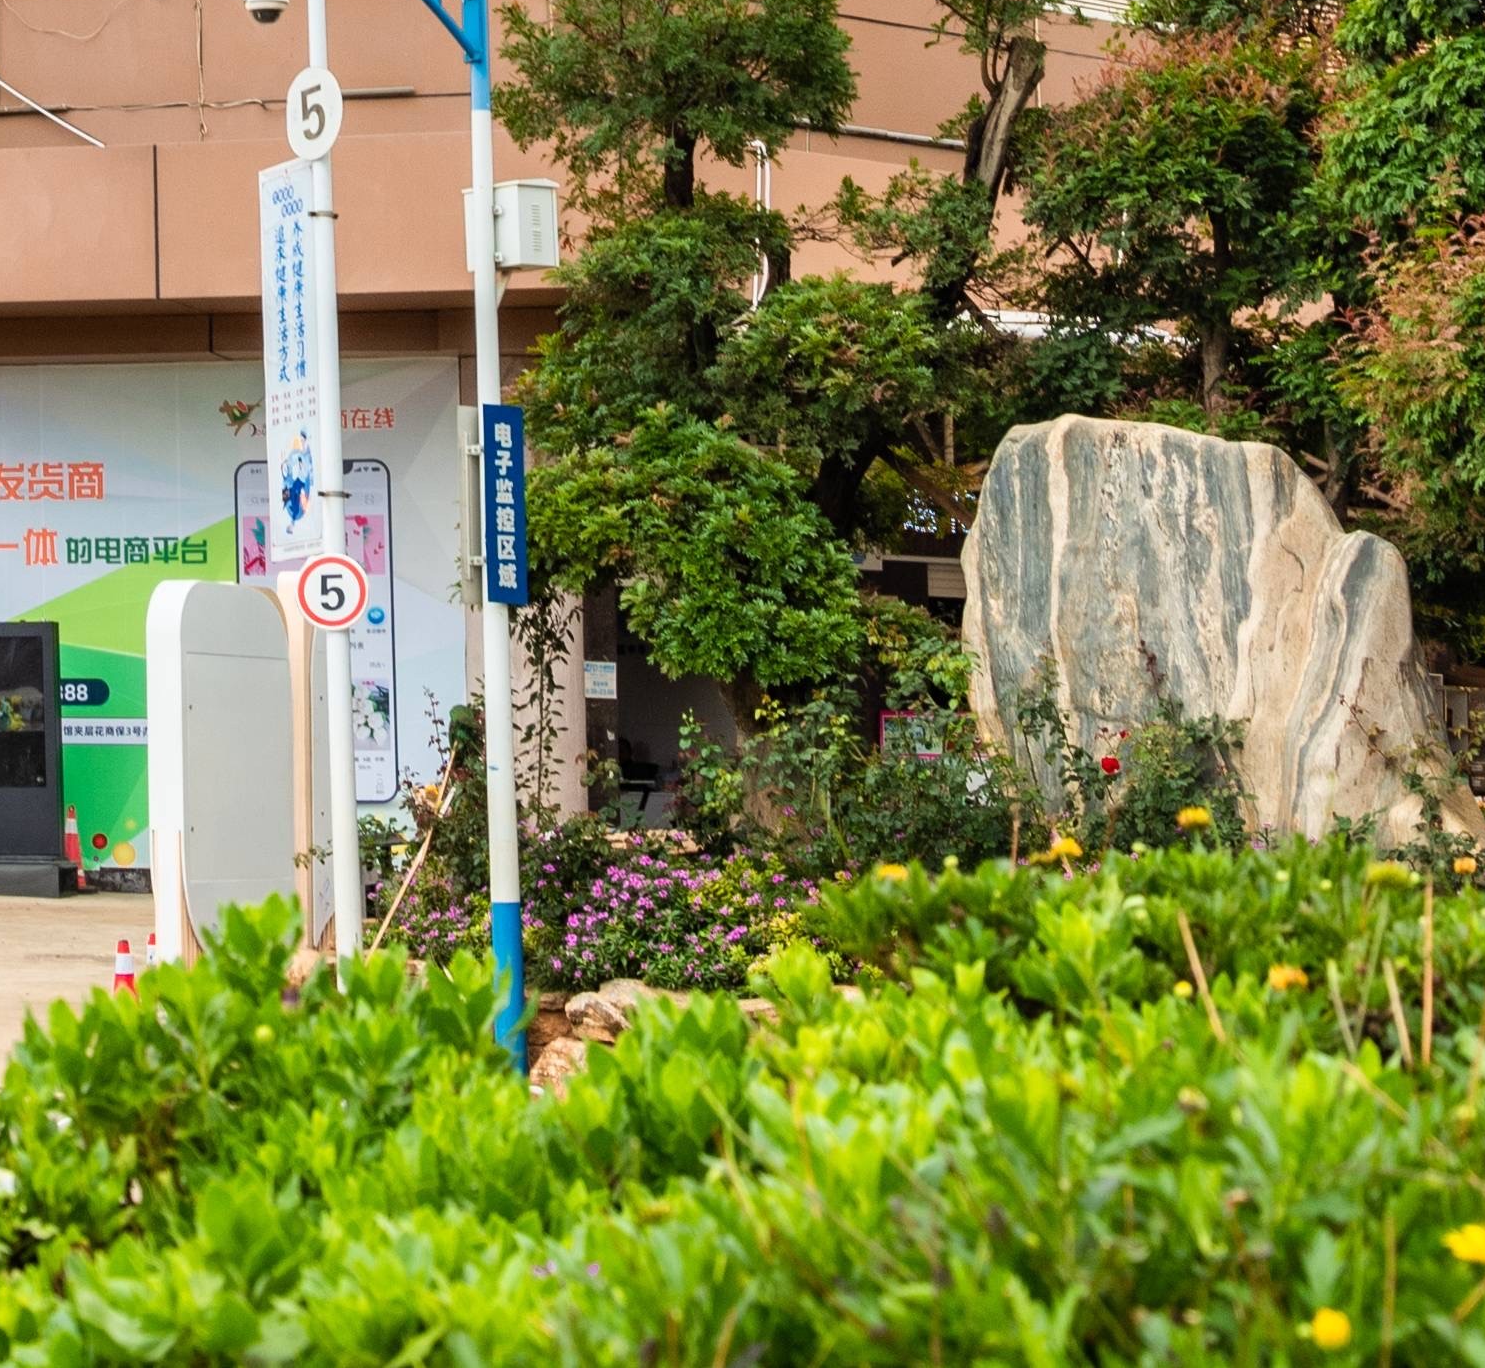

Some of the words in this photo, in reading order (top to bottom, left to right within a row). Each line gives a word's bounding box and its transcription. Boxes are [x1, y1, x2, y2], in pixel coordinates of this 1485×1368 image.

[300, 84, 326, 141] 5
[494, 422, 518, 590] 电子监控区域
[317, 573, 347, 614] 5
